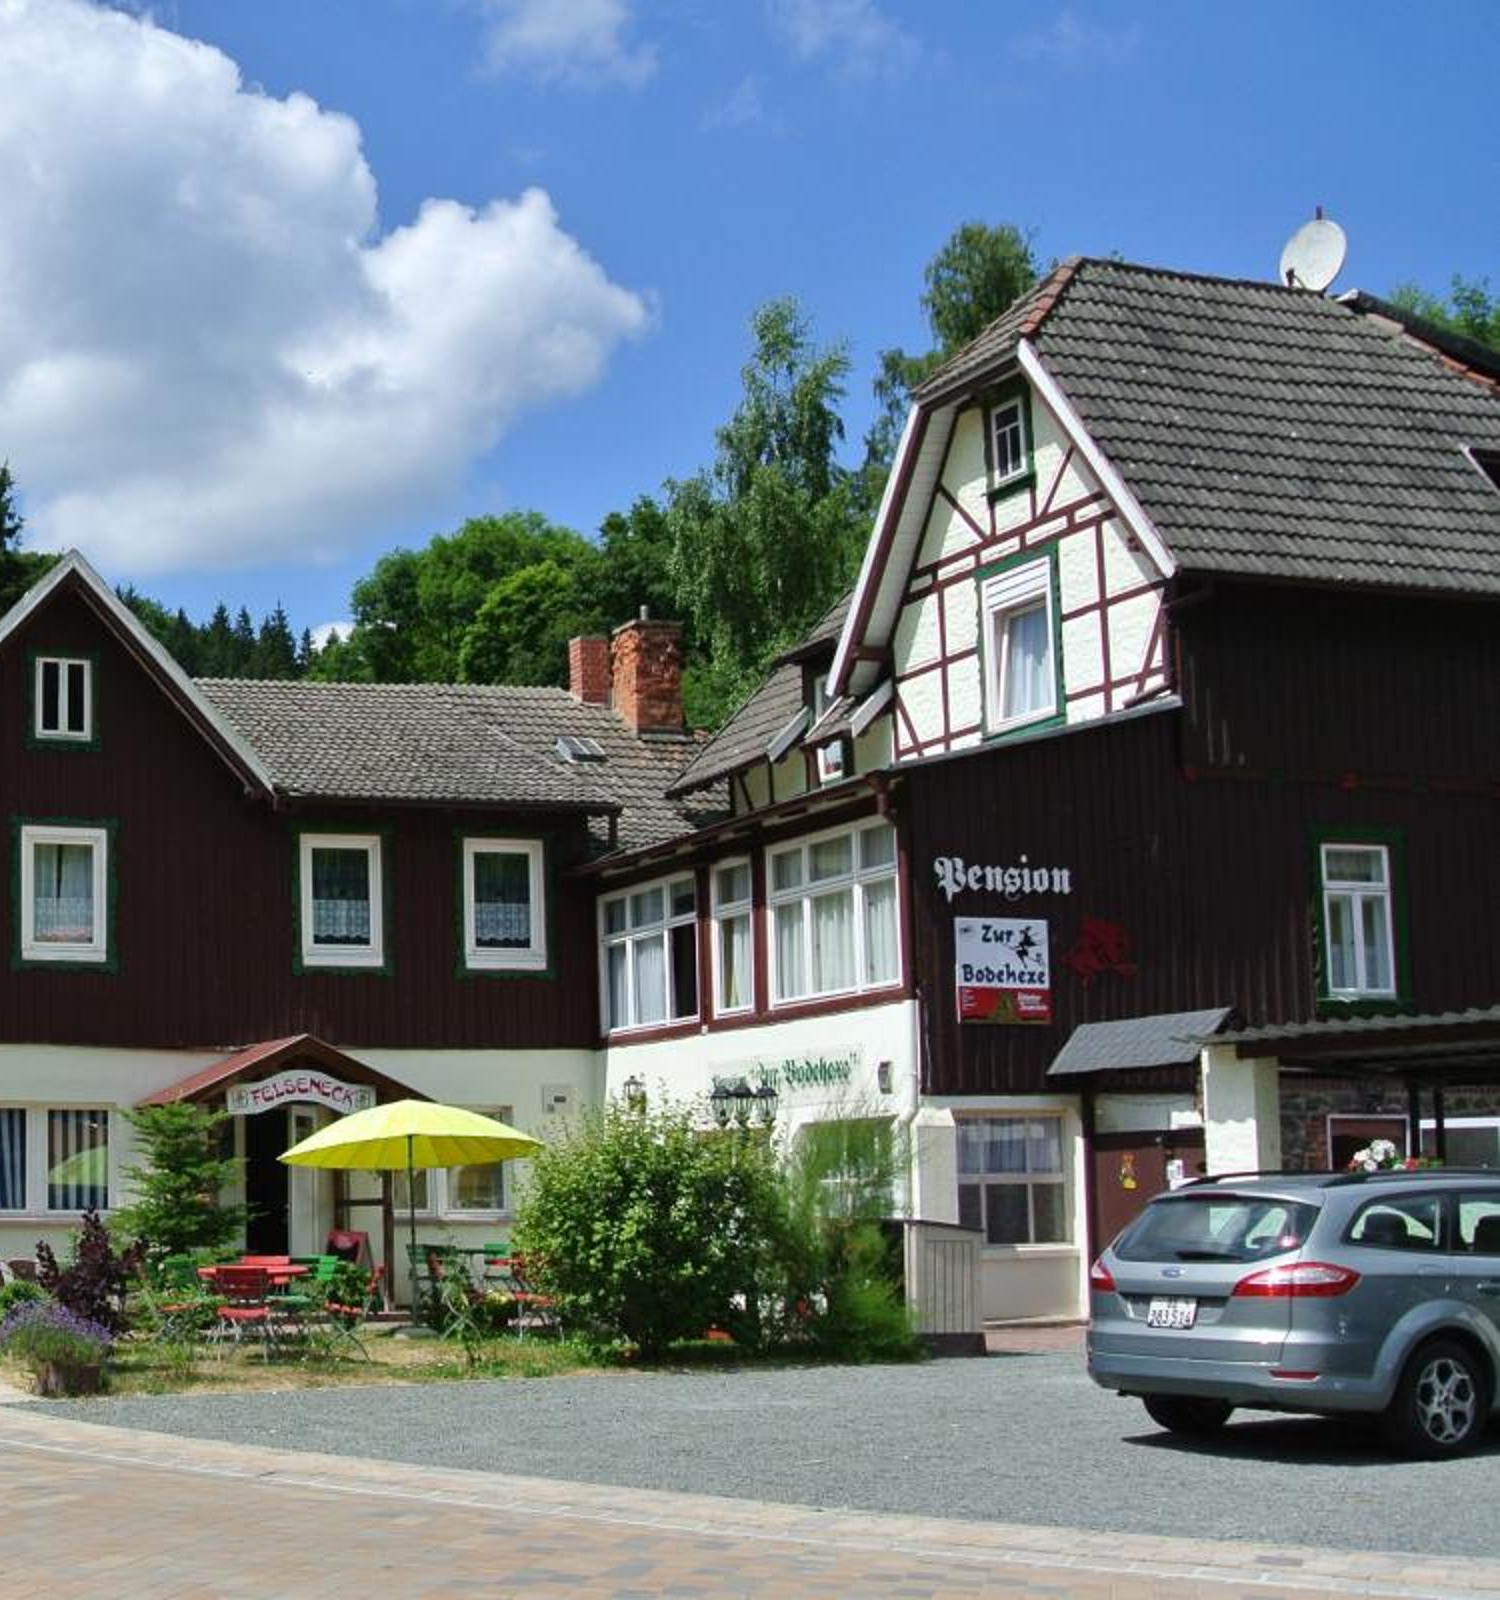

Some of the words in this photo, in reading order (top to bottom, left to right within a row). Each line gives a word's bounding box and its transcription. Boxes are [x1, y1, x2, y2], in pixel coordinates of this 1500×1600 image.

[934, 854, 1073, 903] Pension
[981, 924, 1014, 943] Zur
[962, 963, 1046, 985] Bodehexe
[250, 1077, 356, 1105] FELSENECK
